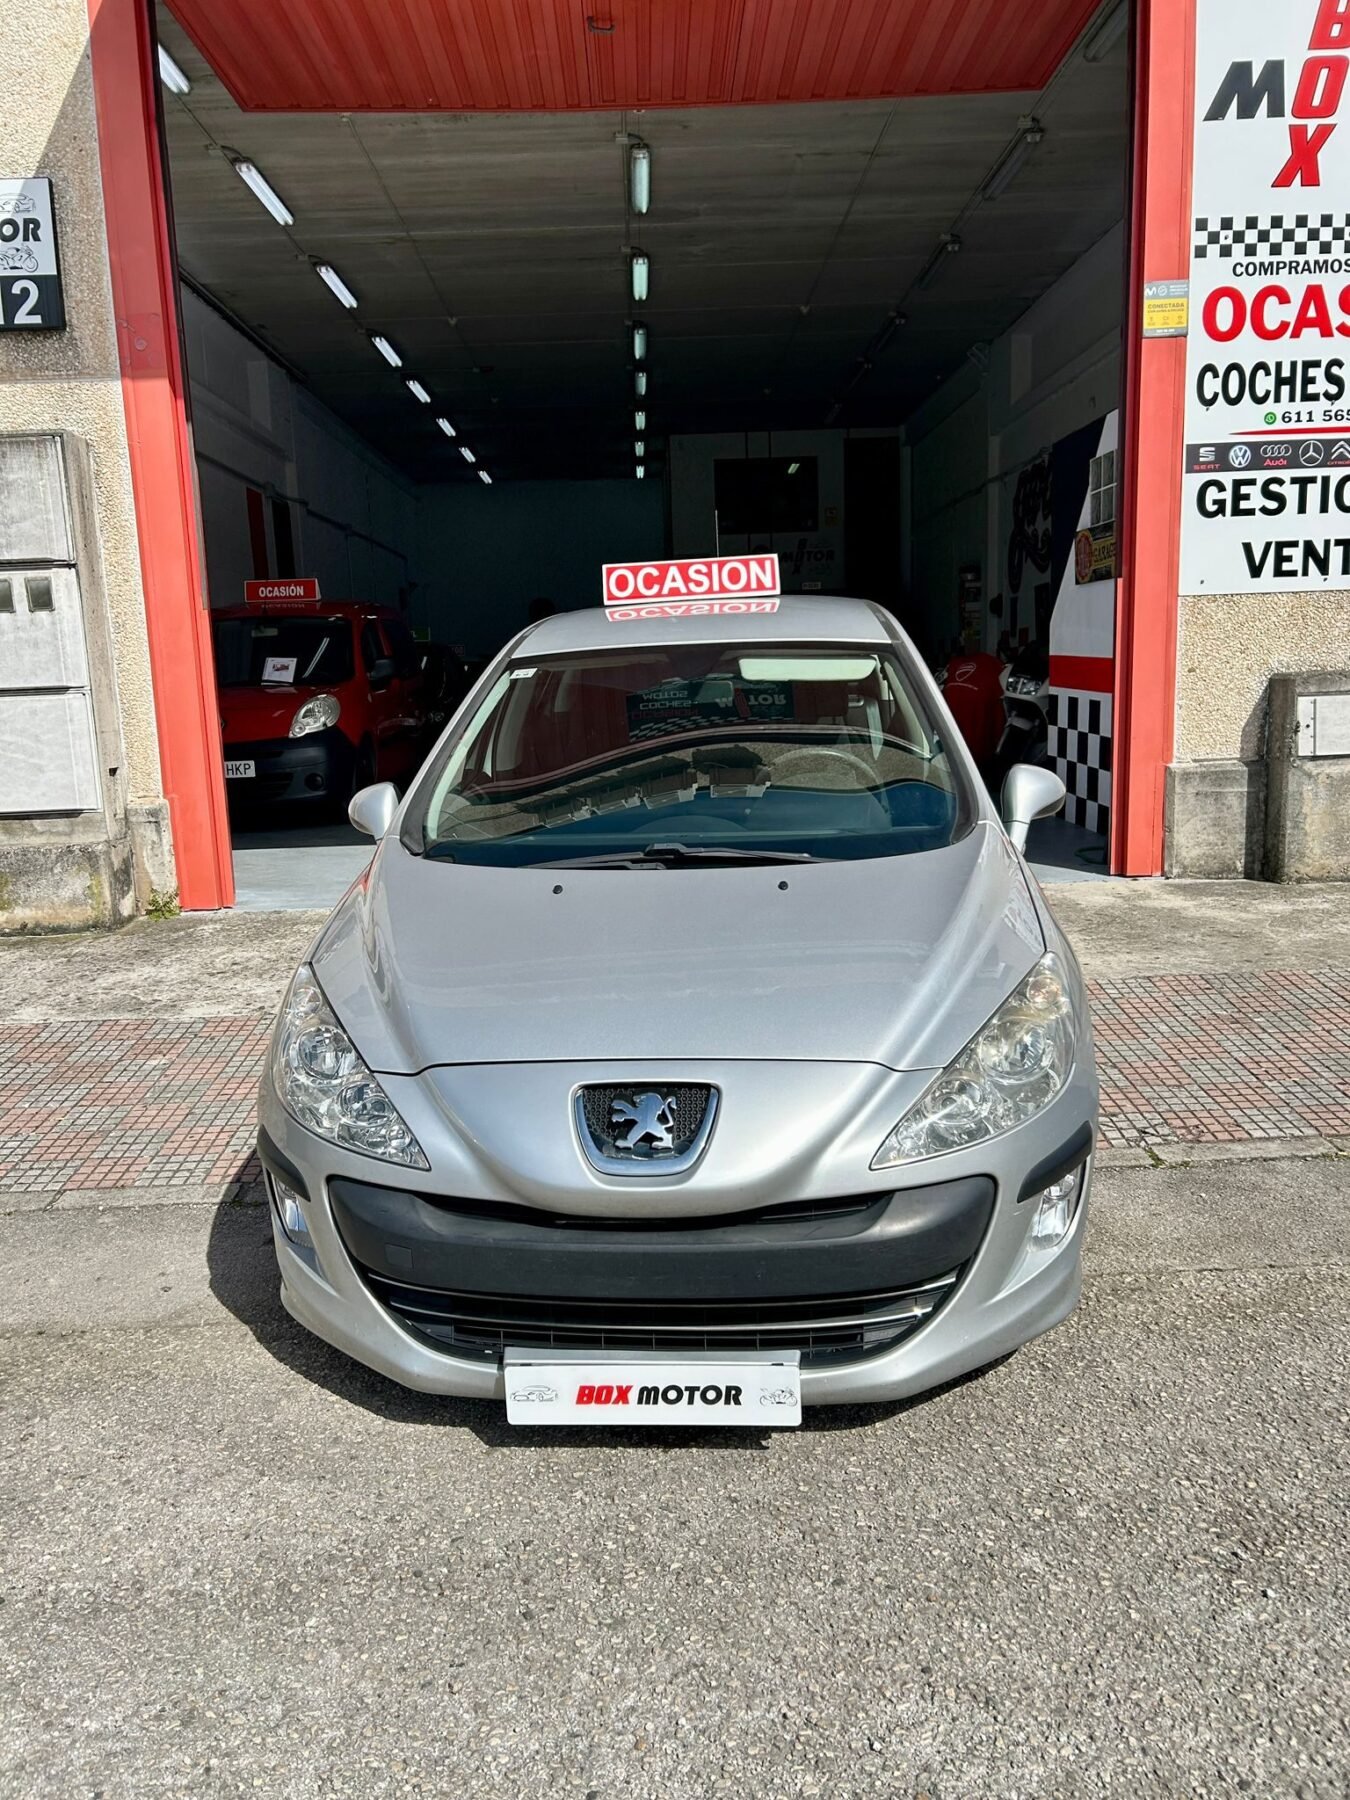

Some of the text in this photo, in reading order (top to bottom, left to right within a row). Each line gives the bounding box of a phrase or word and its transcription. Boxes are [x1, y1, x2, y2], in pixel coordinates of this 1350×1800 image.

[1196, 357, 1345, 407] COCHES
[1281, 410, 1314, 423] 611
[1264, 458, 1287, 466] Audi
[608, 560, 773, 598] OCASION
[259, 584, 304, 597] OCASIÓN
[226, 763, 251, 776] HKP
[575, 1384, 742, 1405] BOX MOTOR
